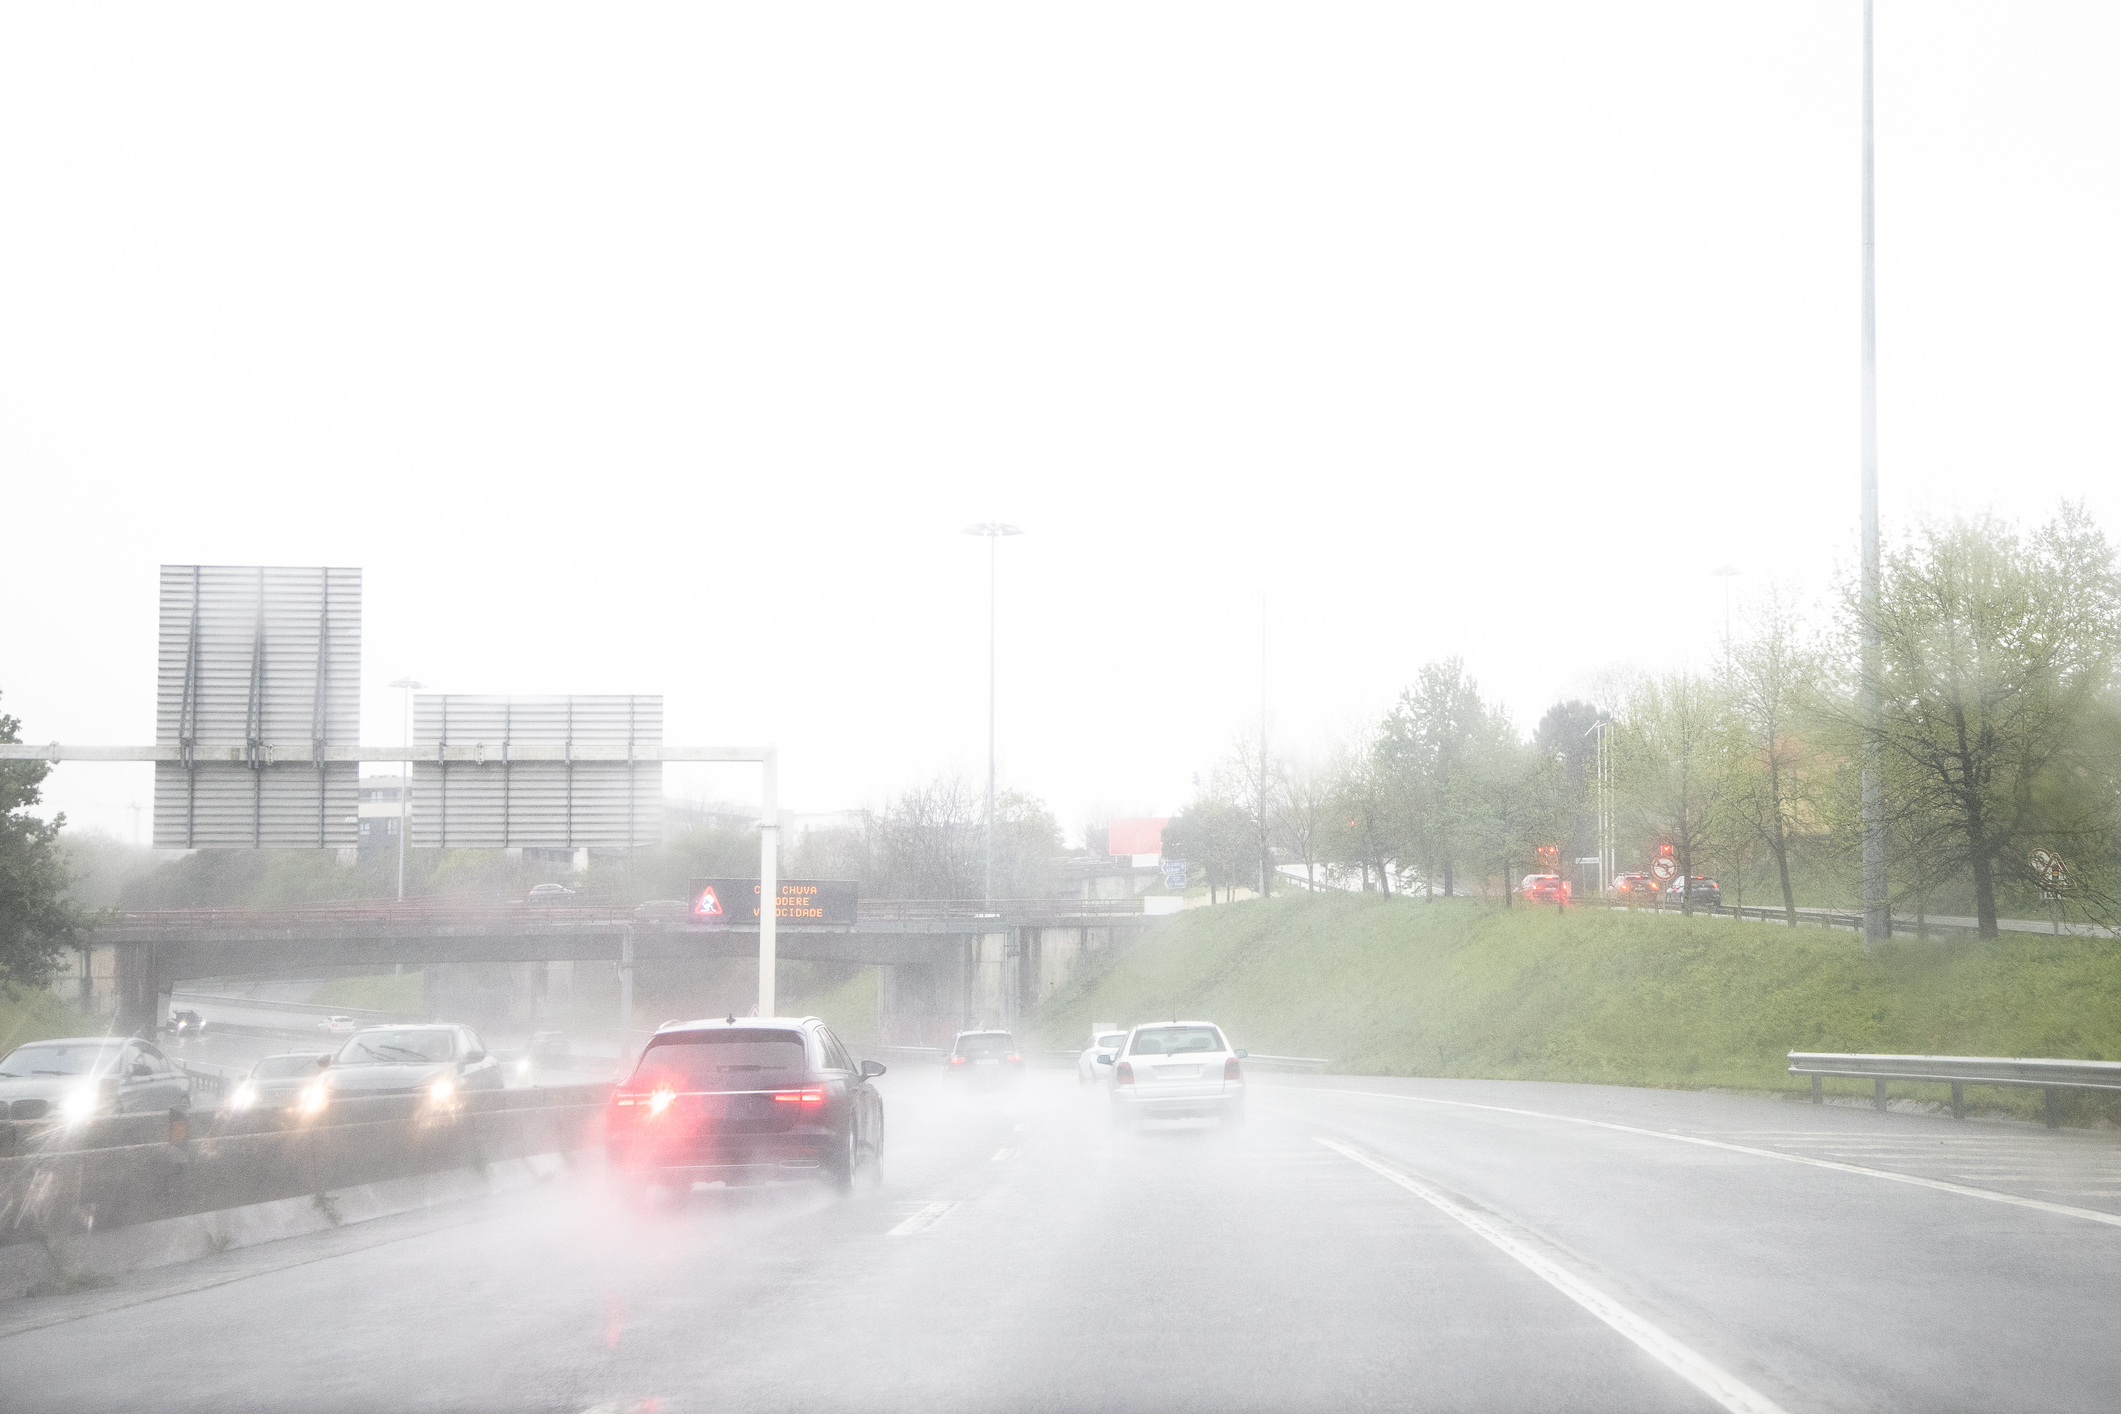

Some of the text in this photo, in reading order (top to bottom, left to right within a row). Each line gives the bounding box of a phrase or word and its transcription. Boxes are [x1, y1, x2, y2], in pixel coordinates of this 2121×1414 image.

[782, 885, 817, 895] CHUVA
[775, 896, 810, 906] ODERE
[753, 907, 823, 917] VOCIDADE
